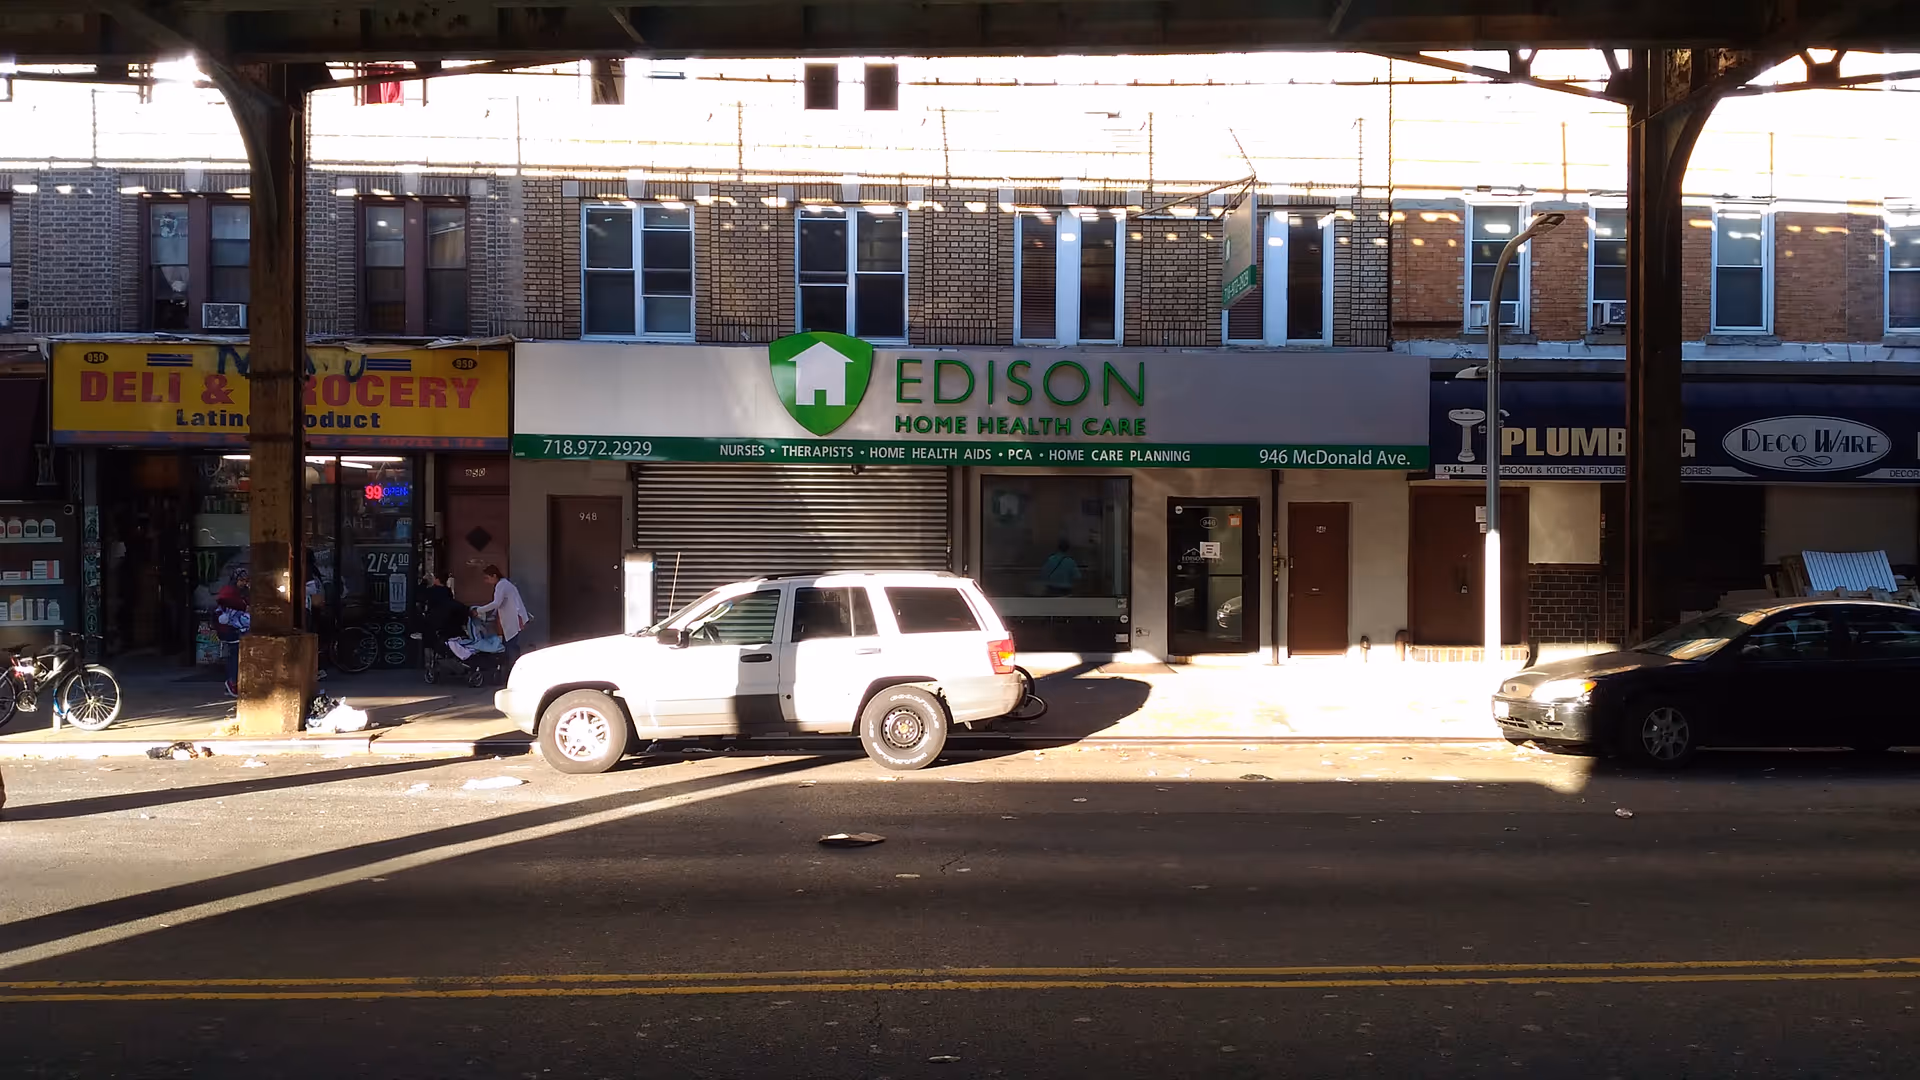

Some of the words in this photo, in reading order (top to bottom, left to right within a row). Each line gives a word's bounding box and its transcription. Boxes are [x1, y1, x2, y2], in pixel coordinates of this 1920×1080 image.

[87, 352, 106, 363] 950
[455, 359, 474, 369] 950
[80, 370, 180, 403] DELI
[201, 373, 235, 404] &
[303, 373, 480, 408] ROCERY
[896, 357, 1145, 407] EDISON
[176, 408, 250, 426] Latin
[304, 411, 381, 428] oduct
[895, 415, 967, 435] HOME
[978, 417, 1072, 436] HEALTH
[1082, 417, 1146, 437] CARE
[543, 439, 652, 457] 718.972.2929
[1501, 427, 1696, 457] PLUMBG
[719, 444, 765, 458] NURSES
[781, 445, 854, 459] THERAPISTS
[870, 447, 905, 460] HOME
[912, 447, 958, 460] HEALTH
[963, 448, 992, 461] AIDS
[1007, 449, 1033, 462] PCA
[1049, 449, 1084, 462] HOME
[1091, 449, 1123, 462] CARE
[1129, 449, 1191, 463] PLANNING
[1259, 449, 1288, 465] 946
[1293, 449, 1373, 466] McDonald
[1376, 450, 1411, 466] Ave.
[1443, 465, 1465, 473] 944
[1481, 466, 1533, 474] BHROOM
[1536, 466, 1543, 474] &
[1547, 466, 1586, 474] KITCHEN
[1589, 466, 1627, 474] FIXTURE
[365, 485, 382, 500] 99
[579, 512, 597, 522] 948
